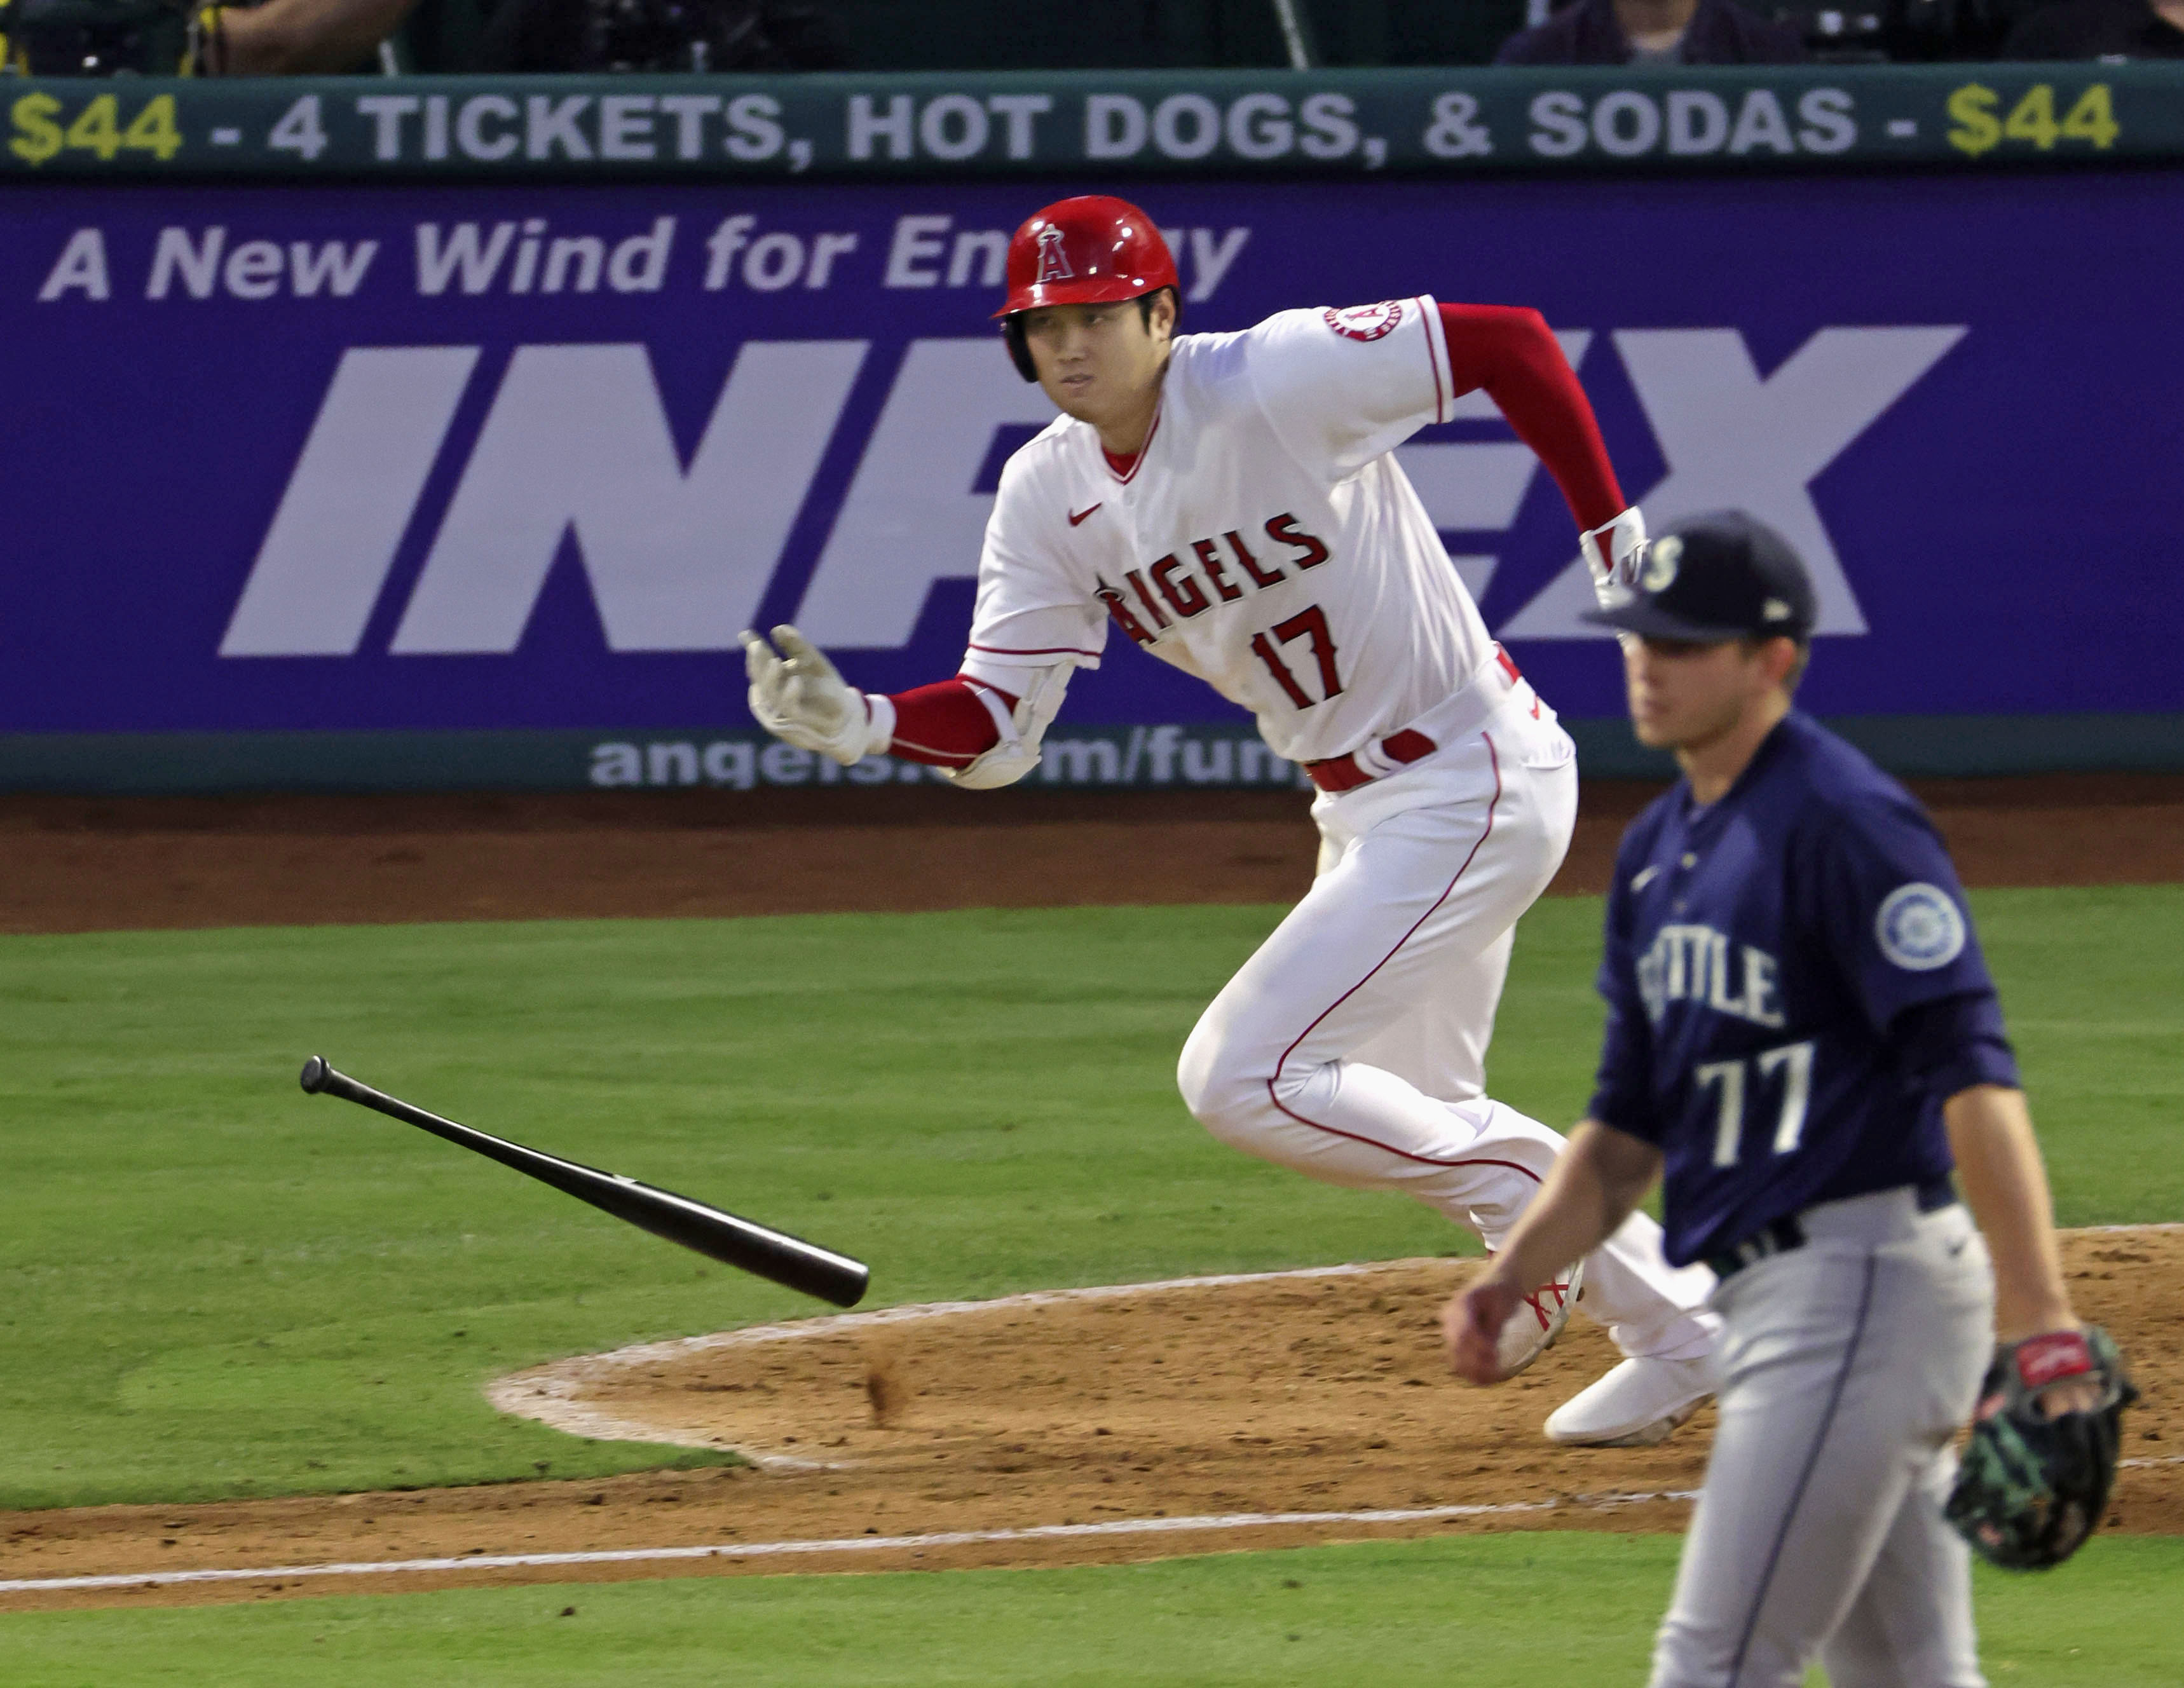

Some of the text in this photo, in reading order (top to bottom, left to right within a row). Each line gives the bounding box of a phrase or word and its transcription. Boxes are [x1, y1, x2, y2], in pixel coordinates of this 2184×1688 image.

[8, 92, 182, 167] $44
[268, 94, 327, 161] 4
[356, 93, 812, 172] TICKETS,
[847, 93, 1054, 161] HOT
[1084, 92, 1389, 170] DOGS,
[1423, 92, 1494, 158] &
[1529, 88, 1858, 158] SODAS
[1946, 83, 2120, 158] $44
[37, 214, 1252, 303] A New Wind for Eny
[1035, 223, 1075, 283] A
[1642, 534, 1684, 593] S
[1252, 604, 1344, 710] 17
[1695, 1040, 1815, 1168] 77
